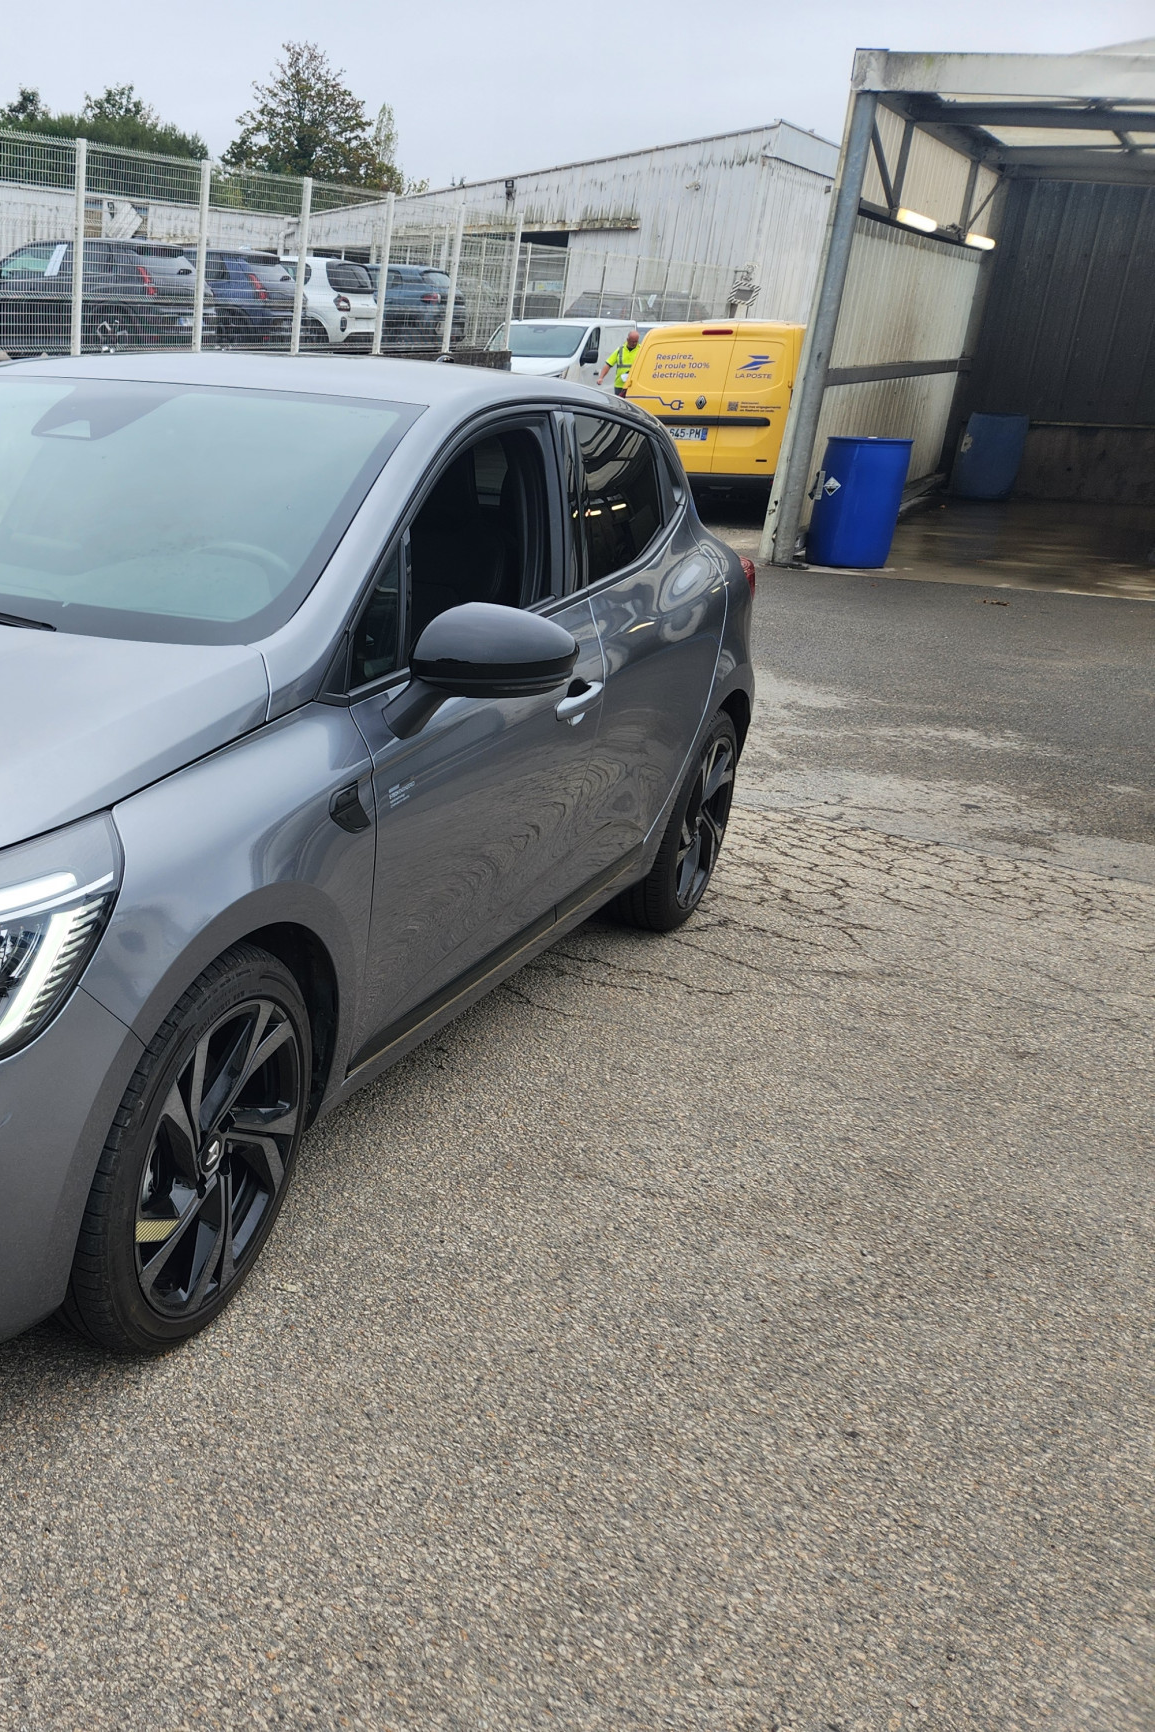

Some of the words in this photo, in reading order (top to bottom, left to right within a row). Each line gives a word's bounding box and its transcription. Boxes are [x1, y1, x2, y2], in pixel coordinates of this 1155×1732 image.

[656, 353, 694, 361] Respirez,
[654, 362, 663, 371] je
[652, 371, 697, 379] électrique.
